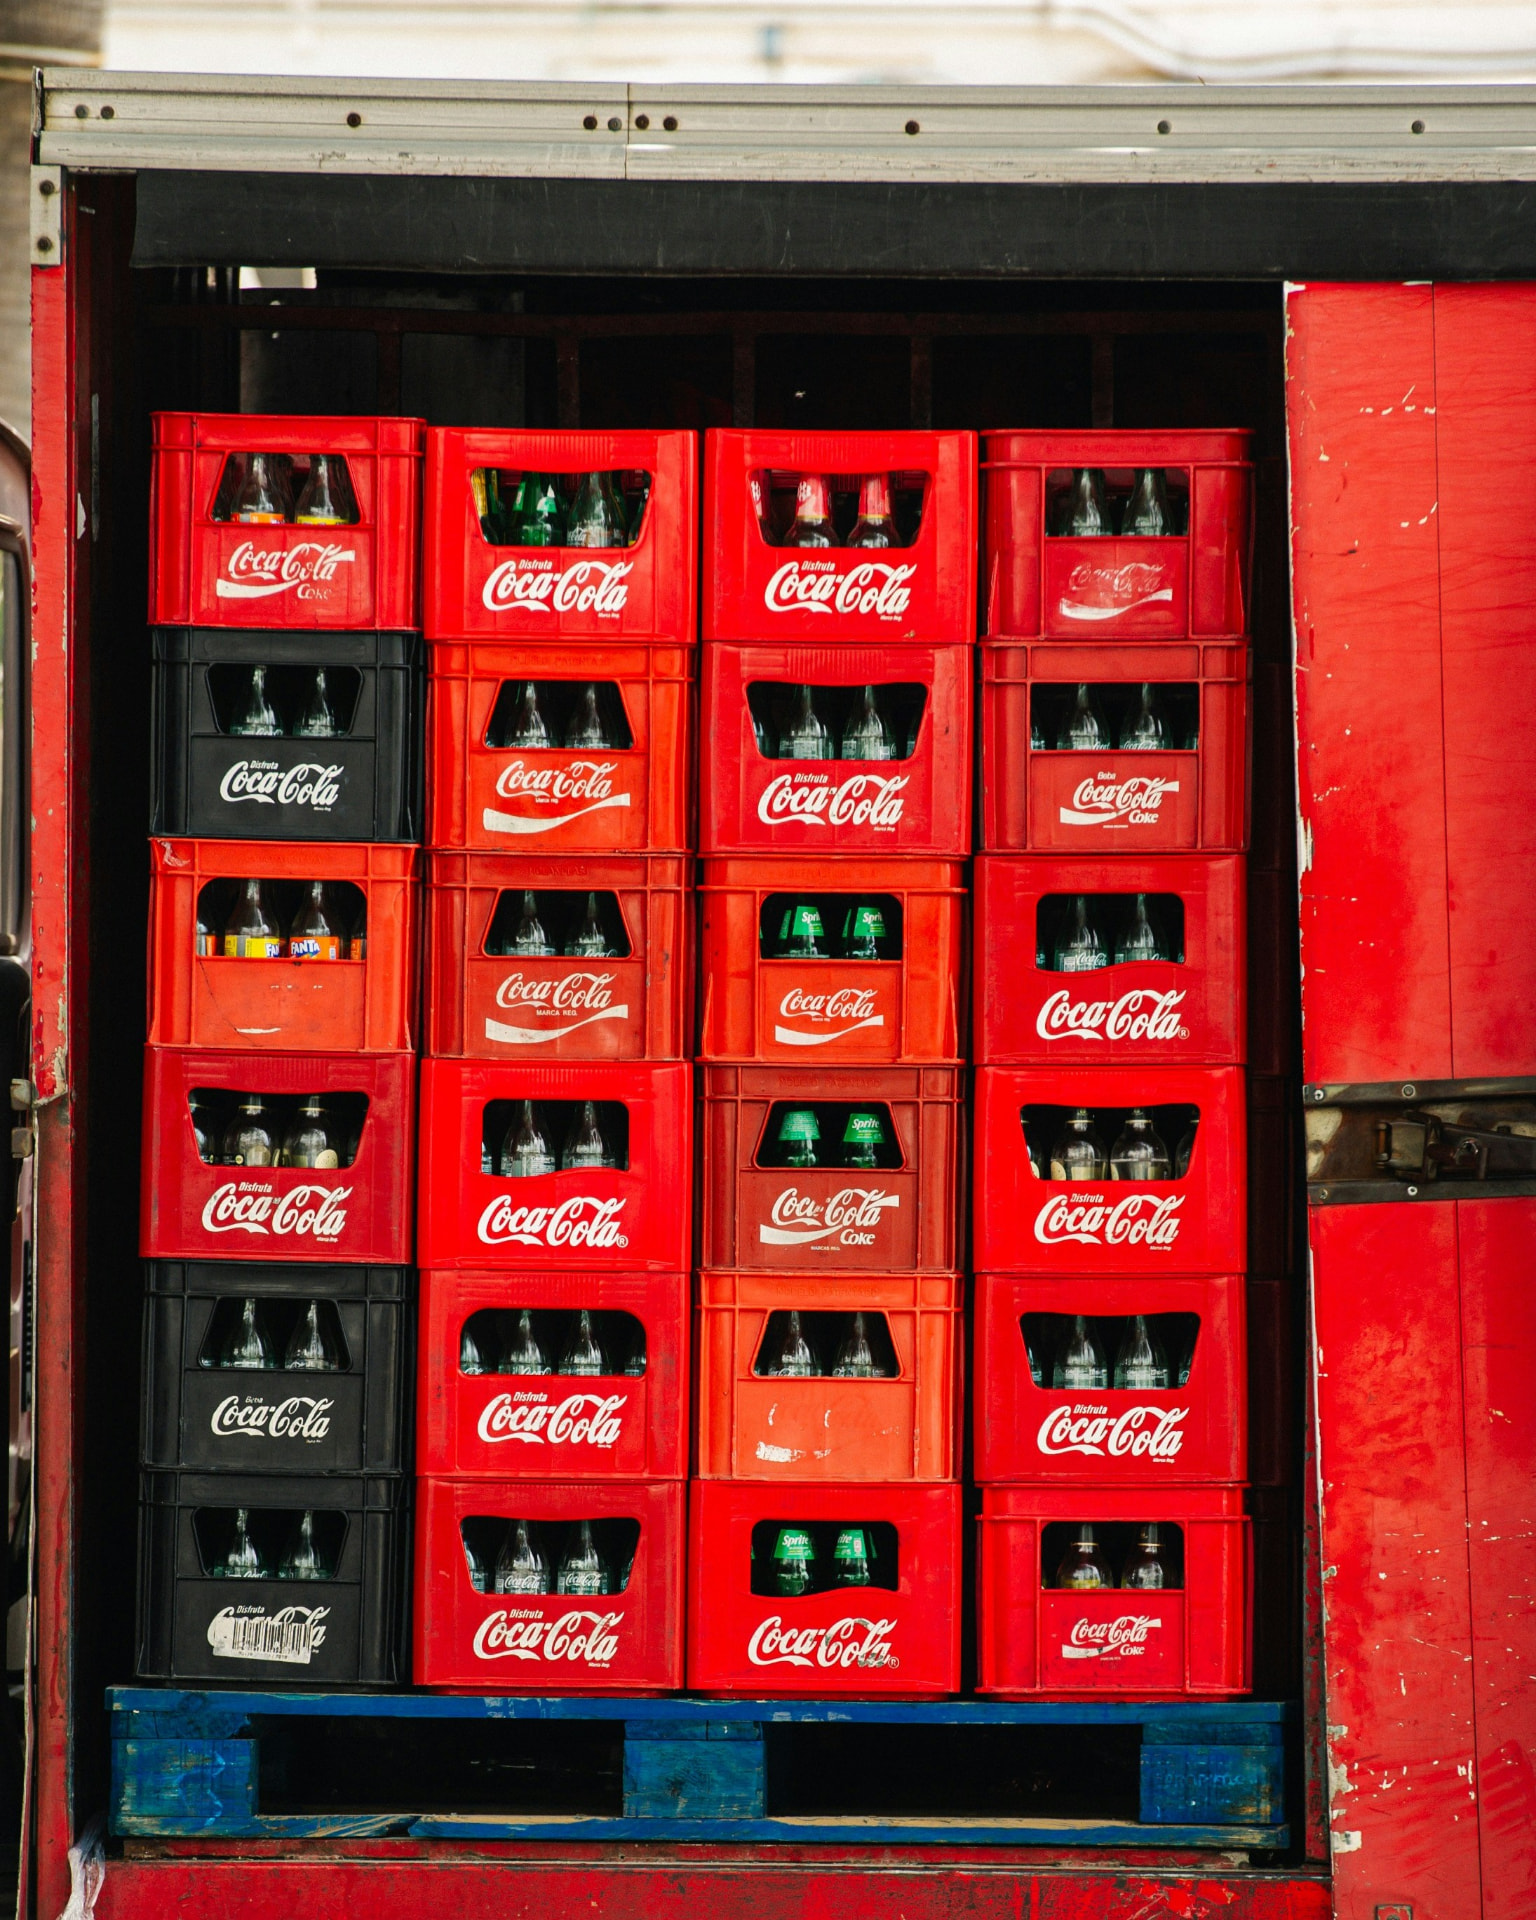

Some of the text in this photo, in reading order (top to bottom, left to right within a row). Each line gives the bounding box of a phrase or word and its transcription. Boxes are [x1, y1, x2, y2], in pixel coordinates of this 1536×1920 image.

[228, 541, 342, 581] Coca-Cola
[519, 559, 552, 570] Disfruta
[801, 560, 835, 571] Disfruta
[482, 560, 634, 612] Coca-Cola
[764, 561, 917, 614] Coca-Cola
[250, 760, 278, 770] Disfruta
[219, 760, 344, 805] Coca-Cola
[496, 760, 618, 798] Coca-Cola
[794, 773, 828, 784] Disfruta
[757, 774, 910, 826] Coca-Cola
[1073, 777, 1166, 810] Coca-Cola
[1128, 810, 1159, 824] Coke
[291, 939, 321, 954] FANTA
[496, 972, 618, 1008] Coca-Cola
[779, 988, 878, 1018] Coca-Cola
[852, 1118, 880, 1130] Sprite
[238, 1182, 272, 1192] Disfruta
[1070, 1193, 1104, 1203] Disfruta
[202, 1183, 353, 1235] Coca-Cola
[1034, 1194, 1186, 1245] Coca-Cola
[840, 1228, 875, 1245] Coke
[513, 1392, 547, 1402] Disfruta
[211, 1395, 335, 1438] Coca-Cola
[477, 1393, 628, 1444] Coca-Cola
[1074, 1404, 1108, 1415] Disfruta
[1037, 1405, 1190, 1456] Coca-Cola
[782, 1534, 809, 1547] Sprite
[237, 1605, 264, 1614] Disfruta
[509, 1609, 543, 1619] Disfruta
[473, 1610, 625, 1661] Coca-Cola
[1071, 1615, 1150, 1645] Coca-Cola
[1120, 1644, 1145, 1655] Coke
